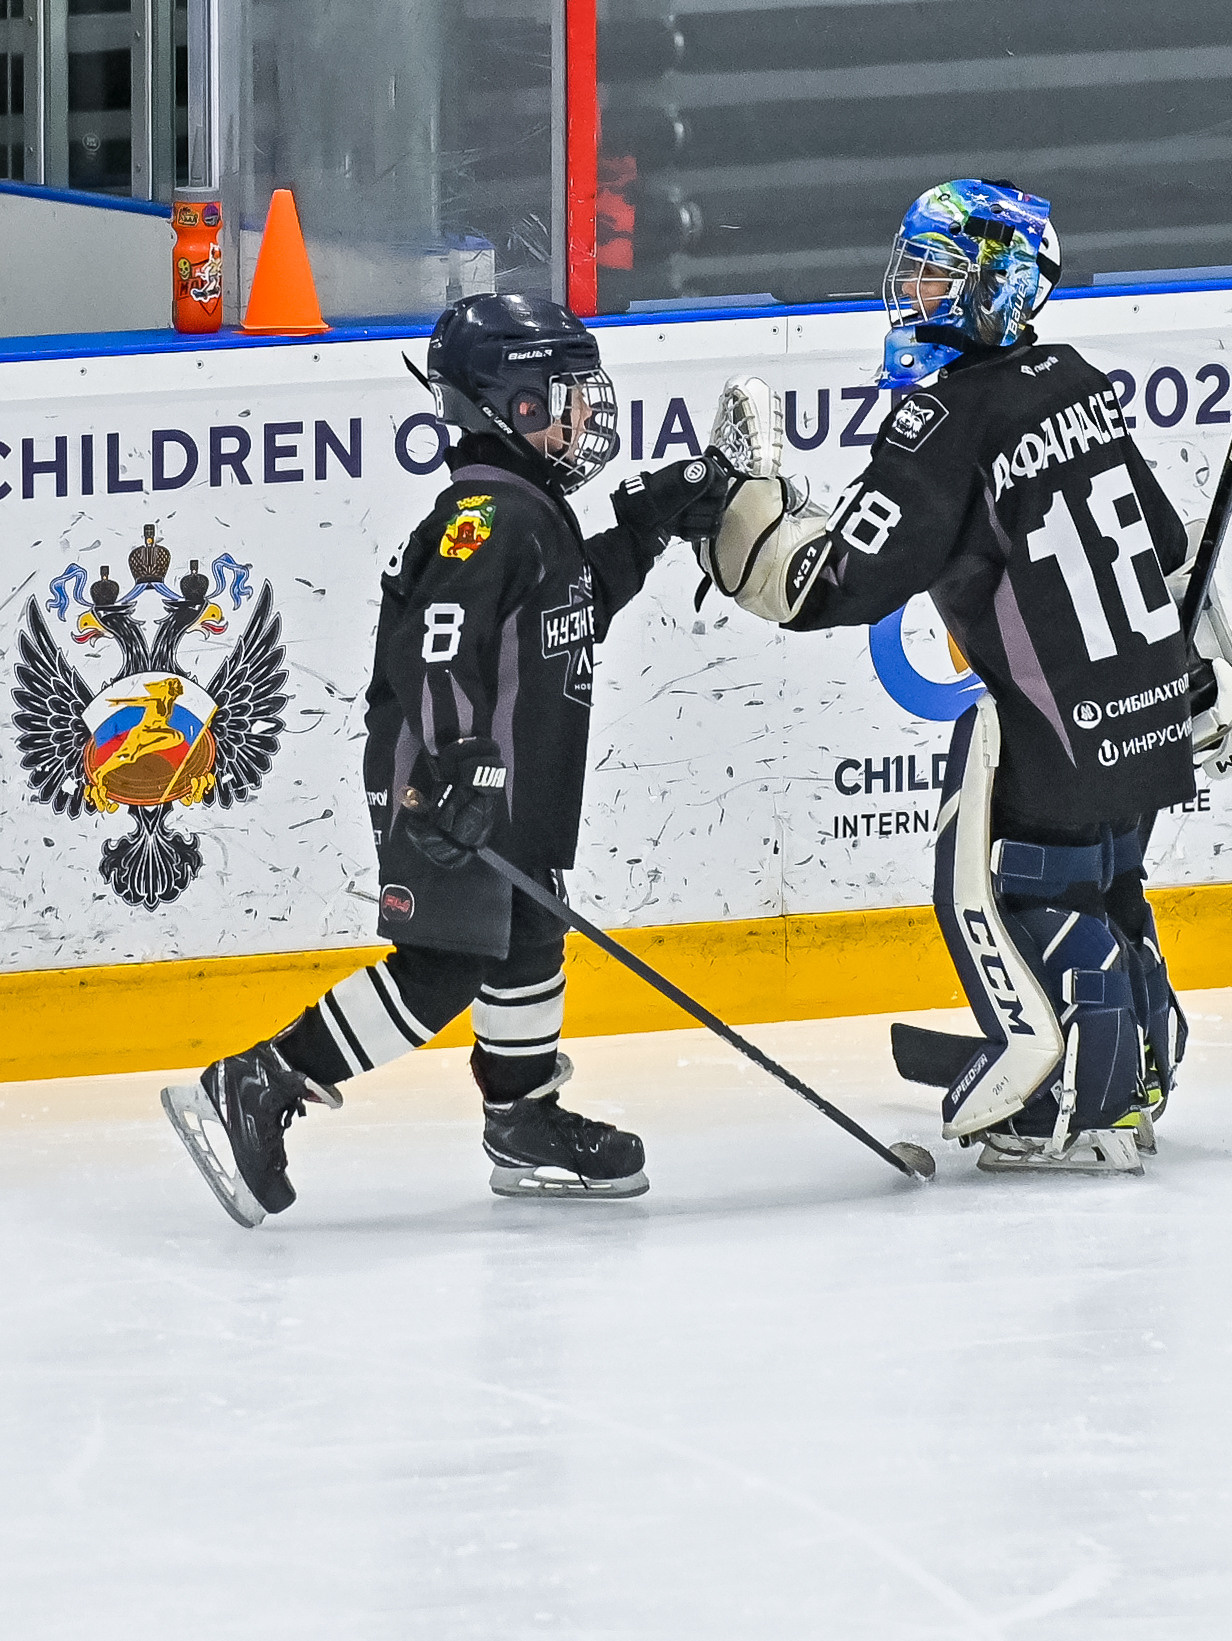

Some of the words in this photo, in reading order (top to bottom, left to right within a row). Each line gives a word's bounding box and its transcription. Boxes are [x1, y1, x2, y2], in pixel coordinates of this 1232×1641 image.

[0, 417, 363, 500] HILDREN
[394, 412, 451, 476] O
[826, 481, 903, 555] 18
[1027, 463, 1181, 662] 18
[421, 603, 466, 664] 8
[834, 753, 949, 796] CHILD
[833, 809, 938, 839] INTERN
[963, 905, 1037, 1037] CCM
